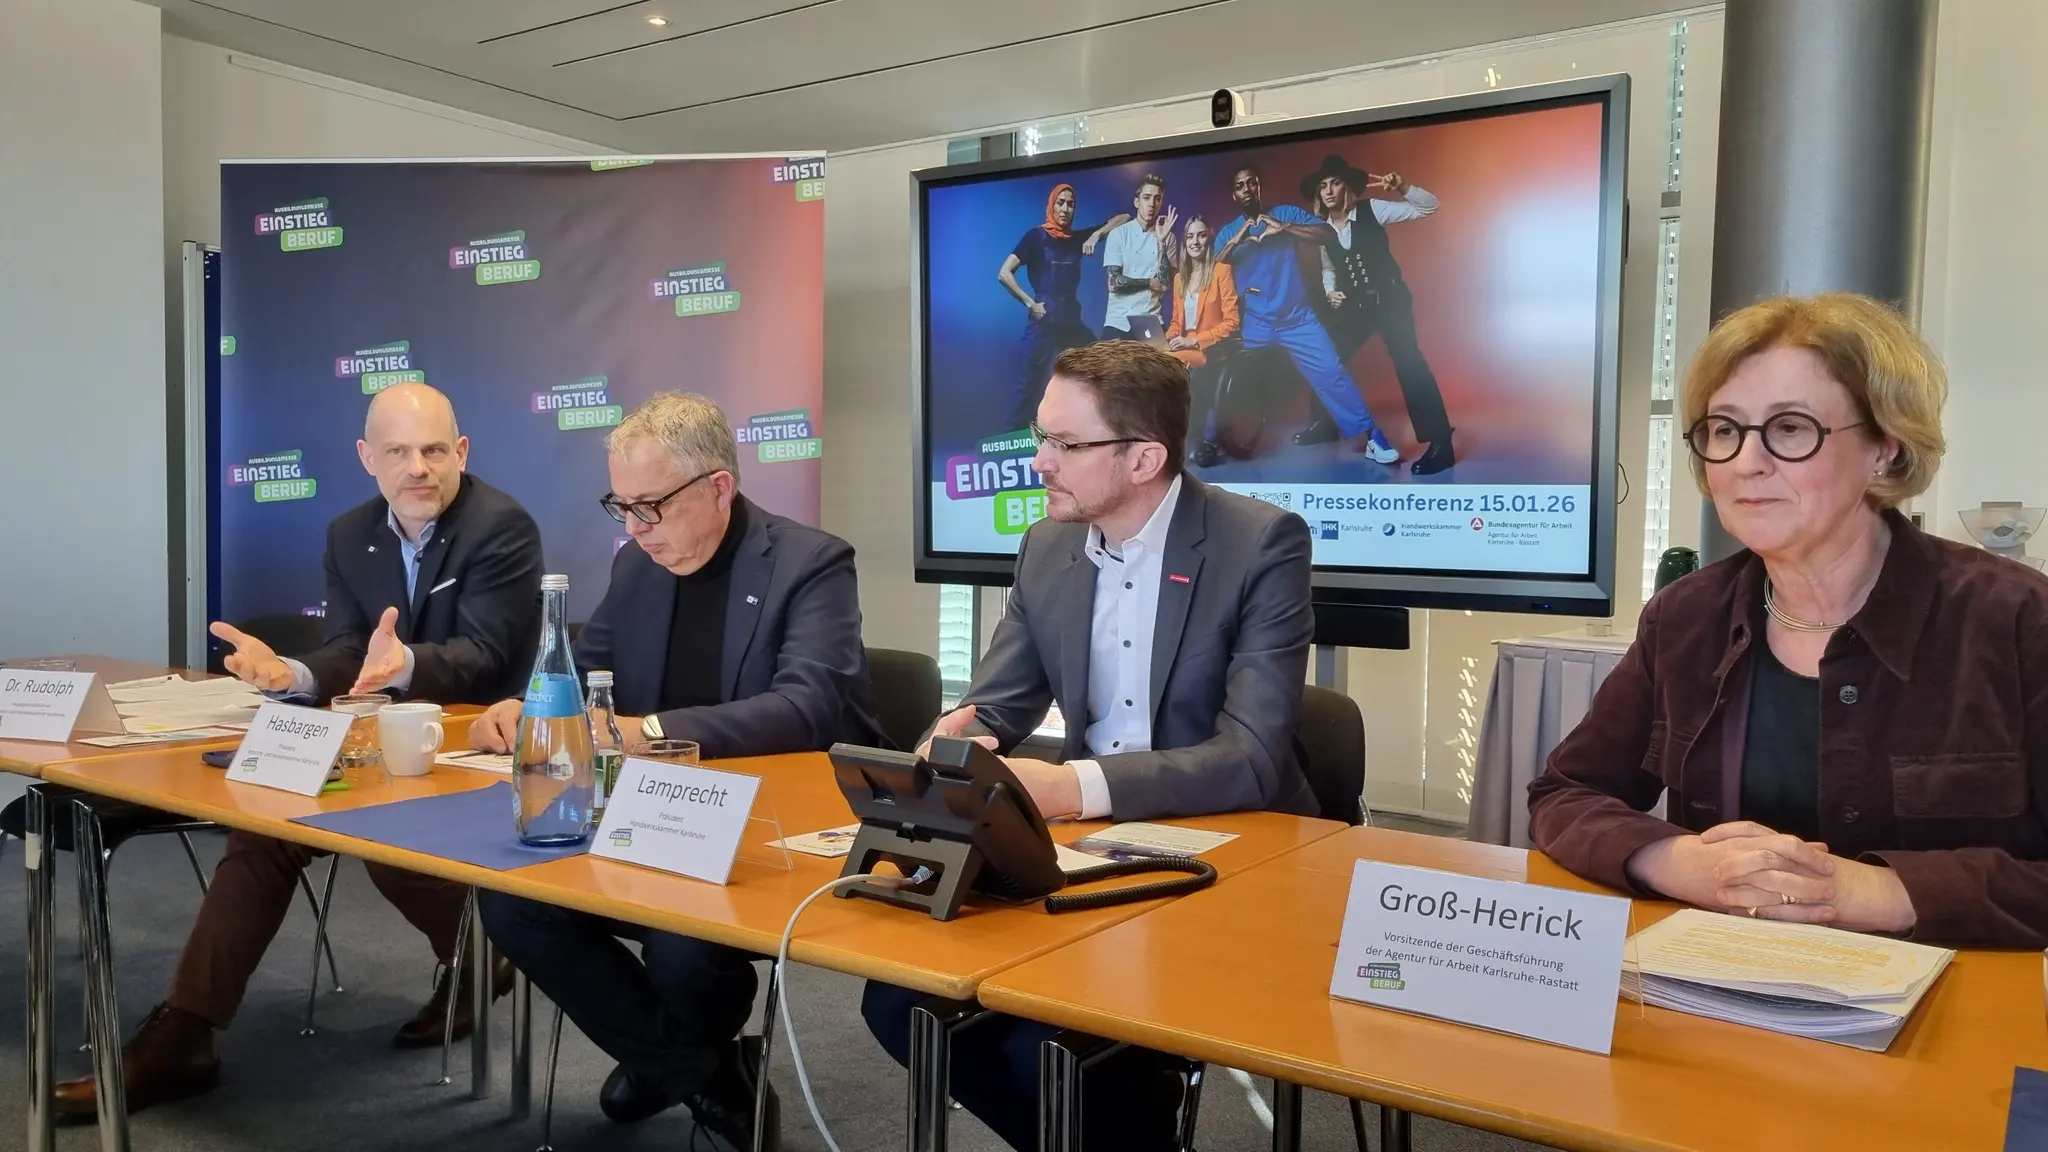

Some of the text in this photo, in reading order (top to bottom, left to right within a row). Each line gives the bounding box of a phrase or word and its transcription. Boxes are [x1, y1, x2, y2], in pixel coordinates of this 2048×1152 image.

[773, 162, 825, 182] EINSTI
[260, 212, 328, 232] EINSTIEG
[287, 230, 337, 248] BERUF
[454, 245, 525, 266] EINSTIEG
[483, 263, 533, 281] BERUF
[654, 275, 725, 297] EINSTIEG
[682, 294, 733, 313] BERUF
[340, 355, 409, 375] EINSTIEG
[537, 390, 607, 410] EINSTIEG
[564, 409, 615, 426] BERUF
[736, 422, 808, 443] EINSTIEG
[765, 441, 816, 459] BERUF
[233, 463, 301, 483] EINSTIEG
[955, 456, 1042, 493] EINST
[261, 481, 309, 498] BERUF
[1303, 493, 1576, 513] Pressekonferenz 15.01.26
[1322, 523, 1338, 531] IHK
[1340, 523, 1373, 532] Karlsruhe
[1401, 522, 1463, 531] Handwerkskammer
[1487, 521, 1539, 529] Bundesagentur
[1540, 521, 1550, 529] für
[4, 678, 74, 697] Dr. Rudolph
[266, 714, 329, 739] Hasbargen
[637, 774, 728, 807] Lamprecht
[1379, 884, 1583, 941] Groß-Herick
[1384, 931, 1564, 973] Vorsitzende der Geschäftsführung
[1359, 967, 1399, 979] EINSTIEG
[1365, 945, 1579, 992] der Agentur für Arbeit Karlsruhe-Rastatt
[1373, 979, 1402, 989] BERUF
